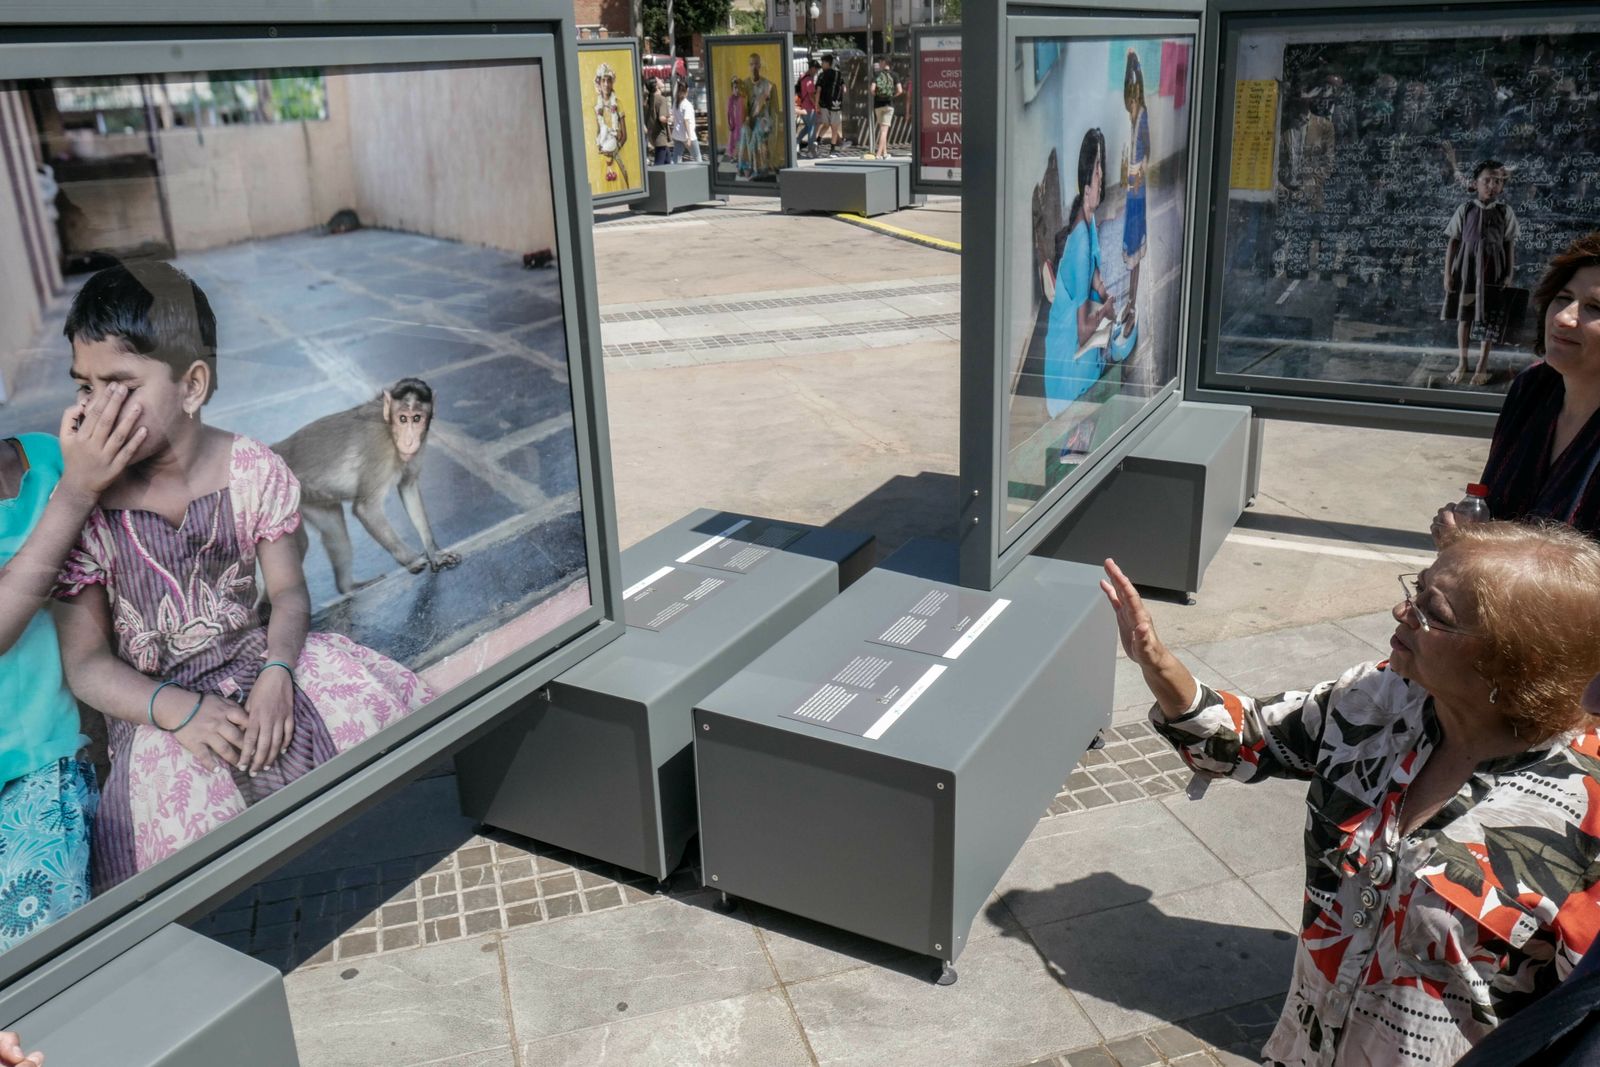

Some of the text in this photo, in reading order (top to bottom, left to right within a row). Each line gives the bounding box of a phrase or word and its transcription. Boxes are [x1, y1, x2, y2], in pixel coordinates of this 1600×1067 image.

[927, 78, 957, 88] GARCÍA
[928, 97, 962, 109] TIER
[931, 112, 962, 125] SUE
[931, 146, 962, 160] DRE
